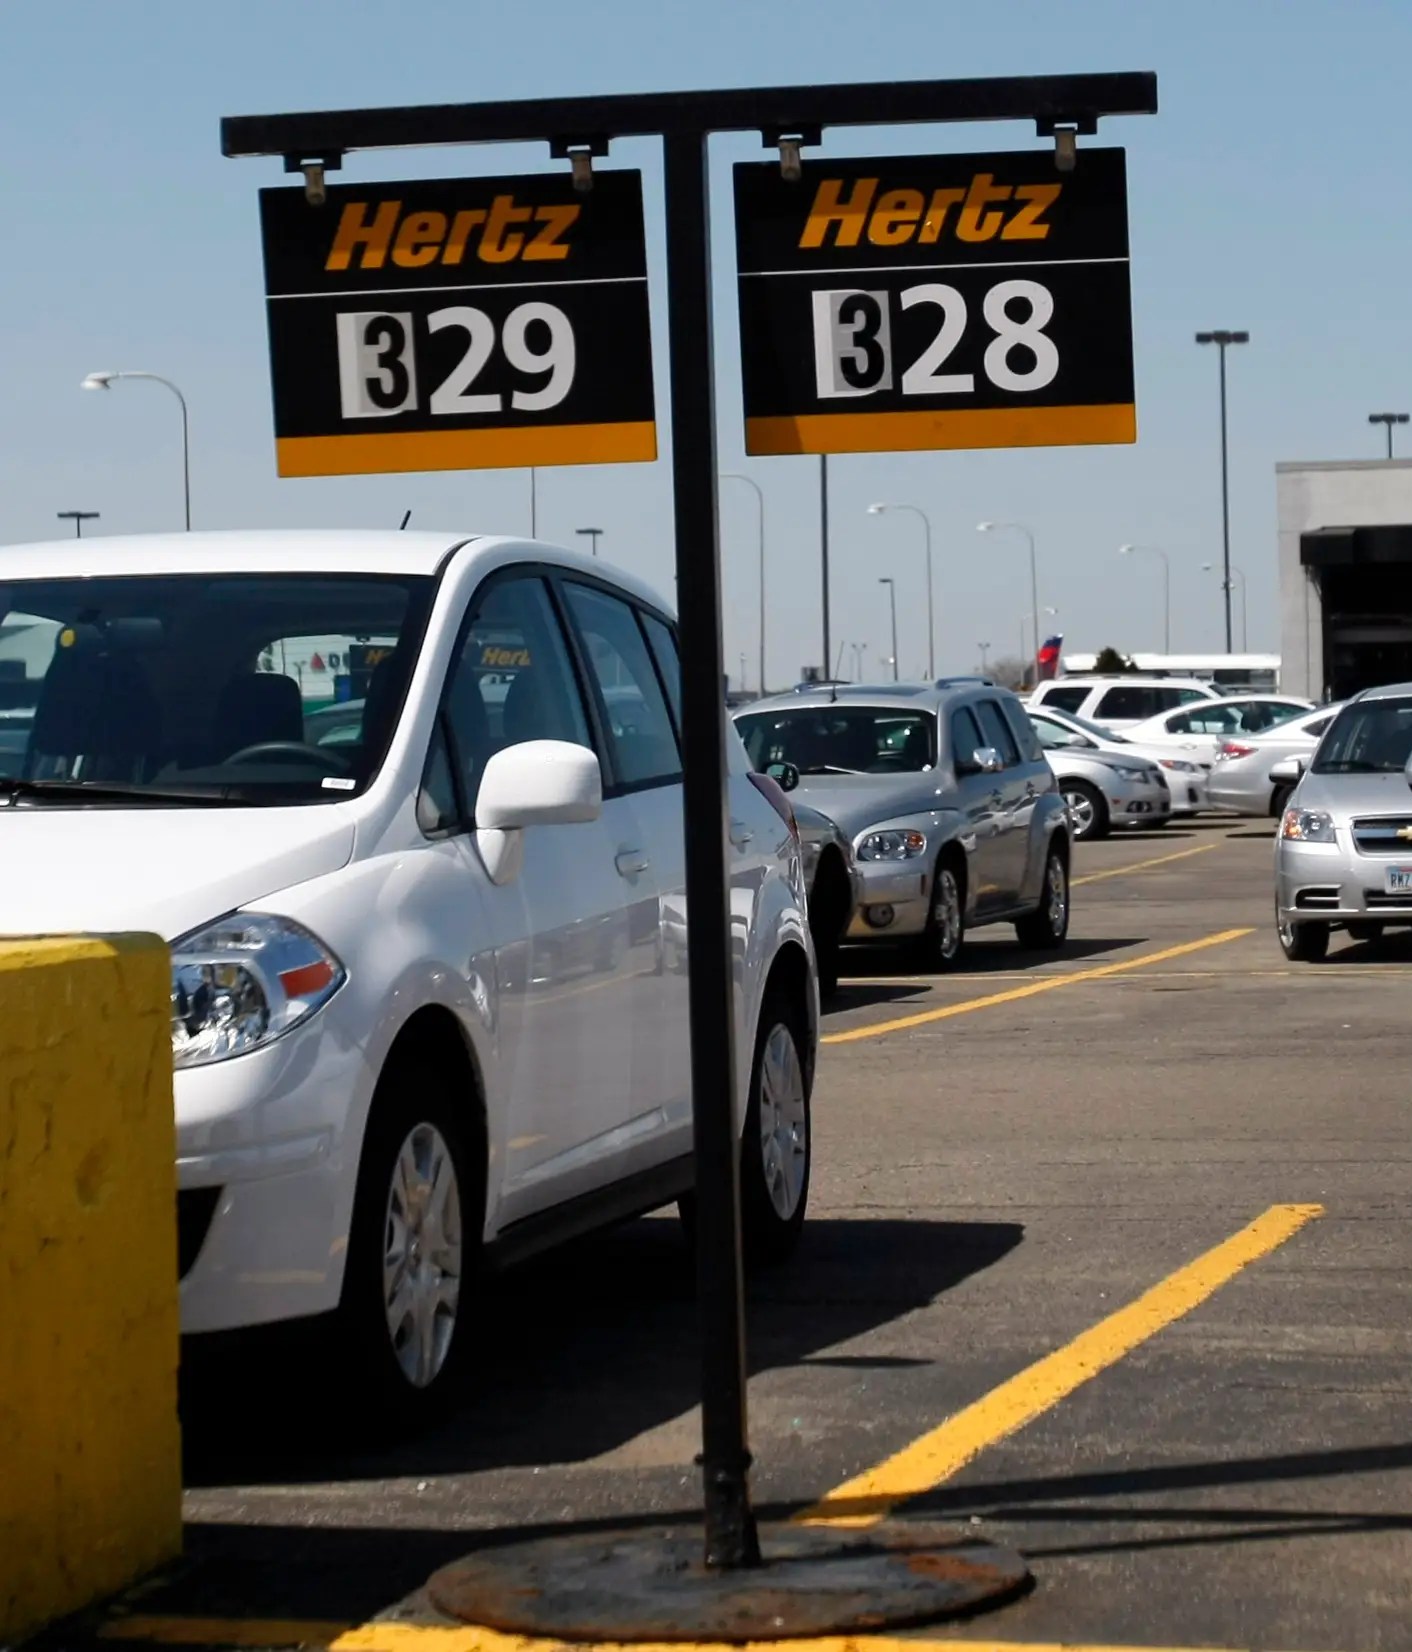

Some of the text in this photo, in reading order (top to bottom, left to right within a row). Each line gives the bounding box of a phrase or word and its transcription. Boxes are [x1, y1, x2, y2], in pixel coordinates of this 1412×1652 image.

[324, 195, 582, 272] Hertz
[798, 173, 1063, 248] Hertz
[363, 302, 577, 416] 329
[837, 279, 1060, 395] 328
